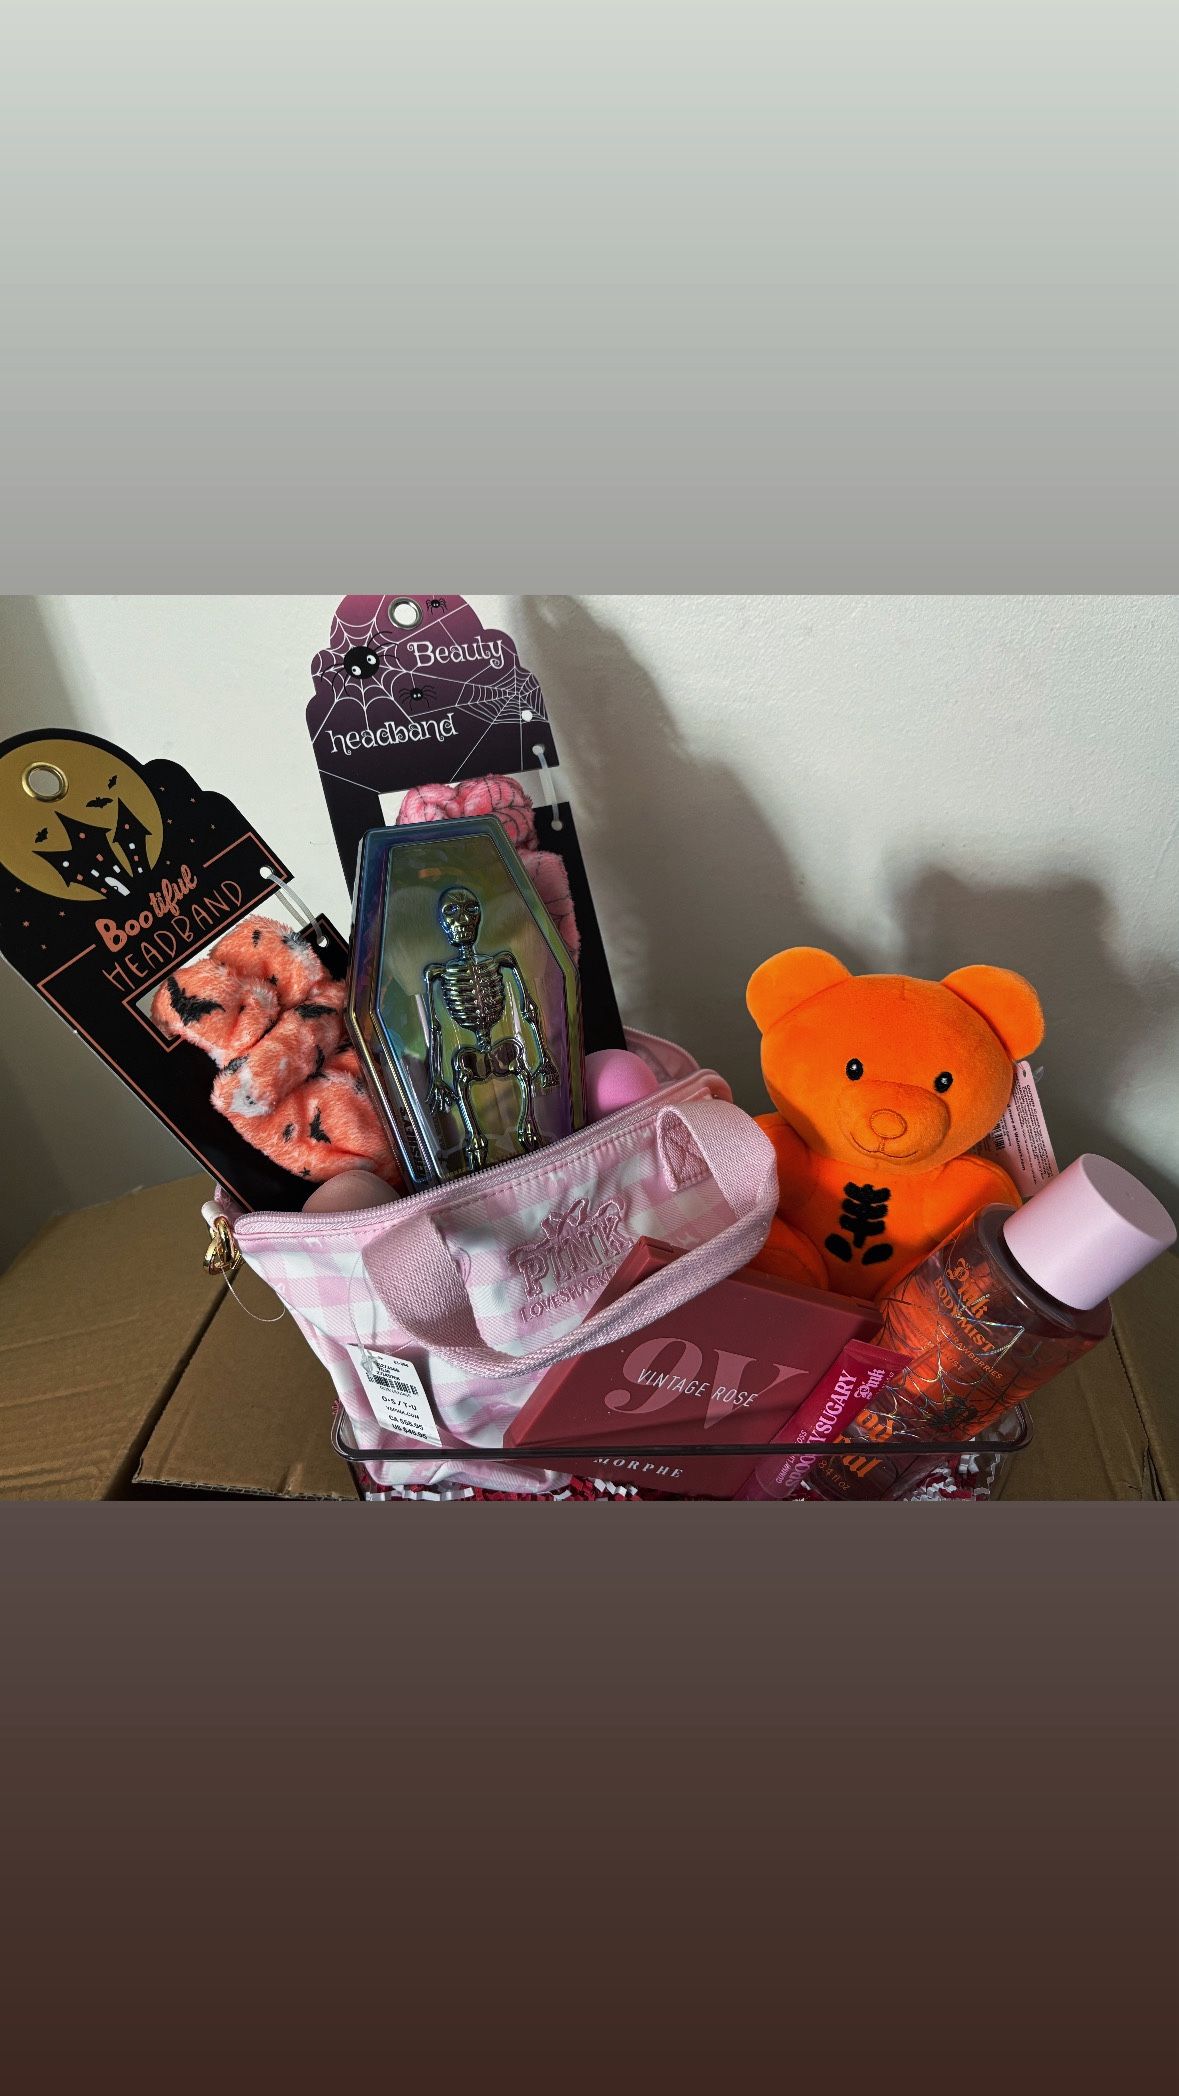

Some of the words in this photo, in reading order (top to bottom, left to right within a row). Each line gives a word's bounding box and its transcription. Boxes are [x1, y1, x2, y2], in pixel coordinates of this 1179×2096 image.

[406, 635, 505, 670] Beauty
[325, 713, 459, 756] headband
[95, 864, 198, 953] Bootiful
[102, 880, 242, 992] HEADBAND
[518, 1215, 634, 1301] PINK
[520, 1263, 618, 1323] LOVESHACKF
[934, 1277, 963, 1317] BODY
[958, 1316, 995, 1352] MIST
[604, 1337, 809, 1429] 9V
[637, 1368, 710, 1397] VINTAGE
[711, 1386, 758, 1407] ROSE
[815, 1369, 857, 1434] SUGARY
